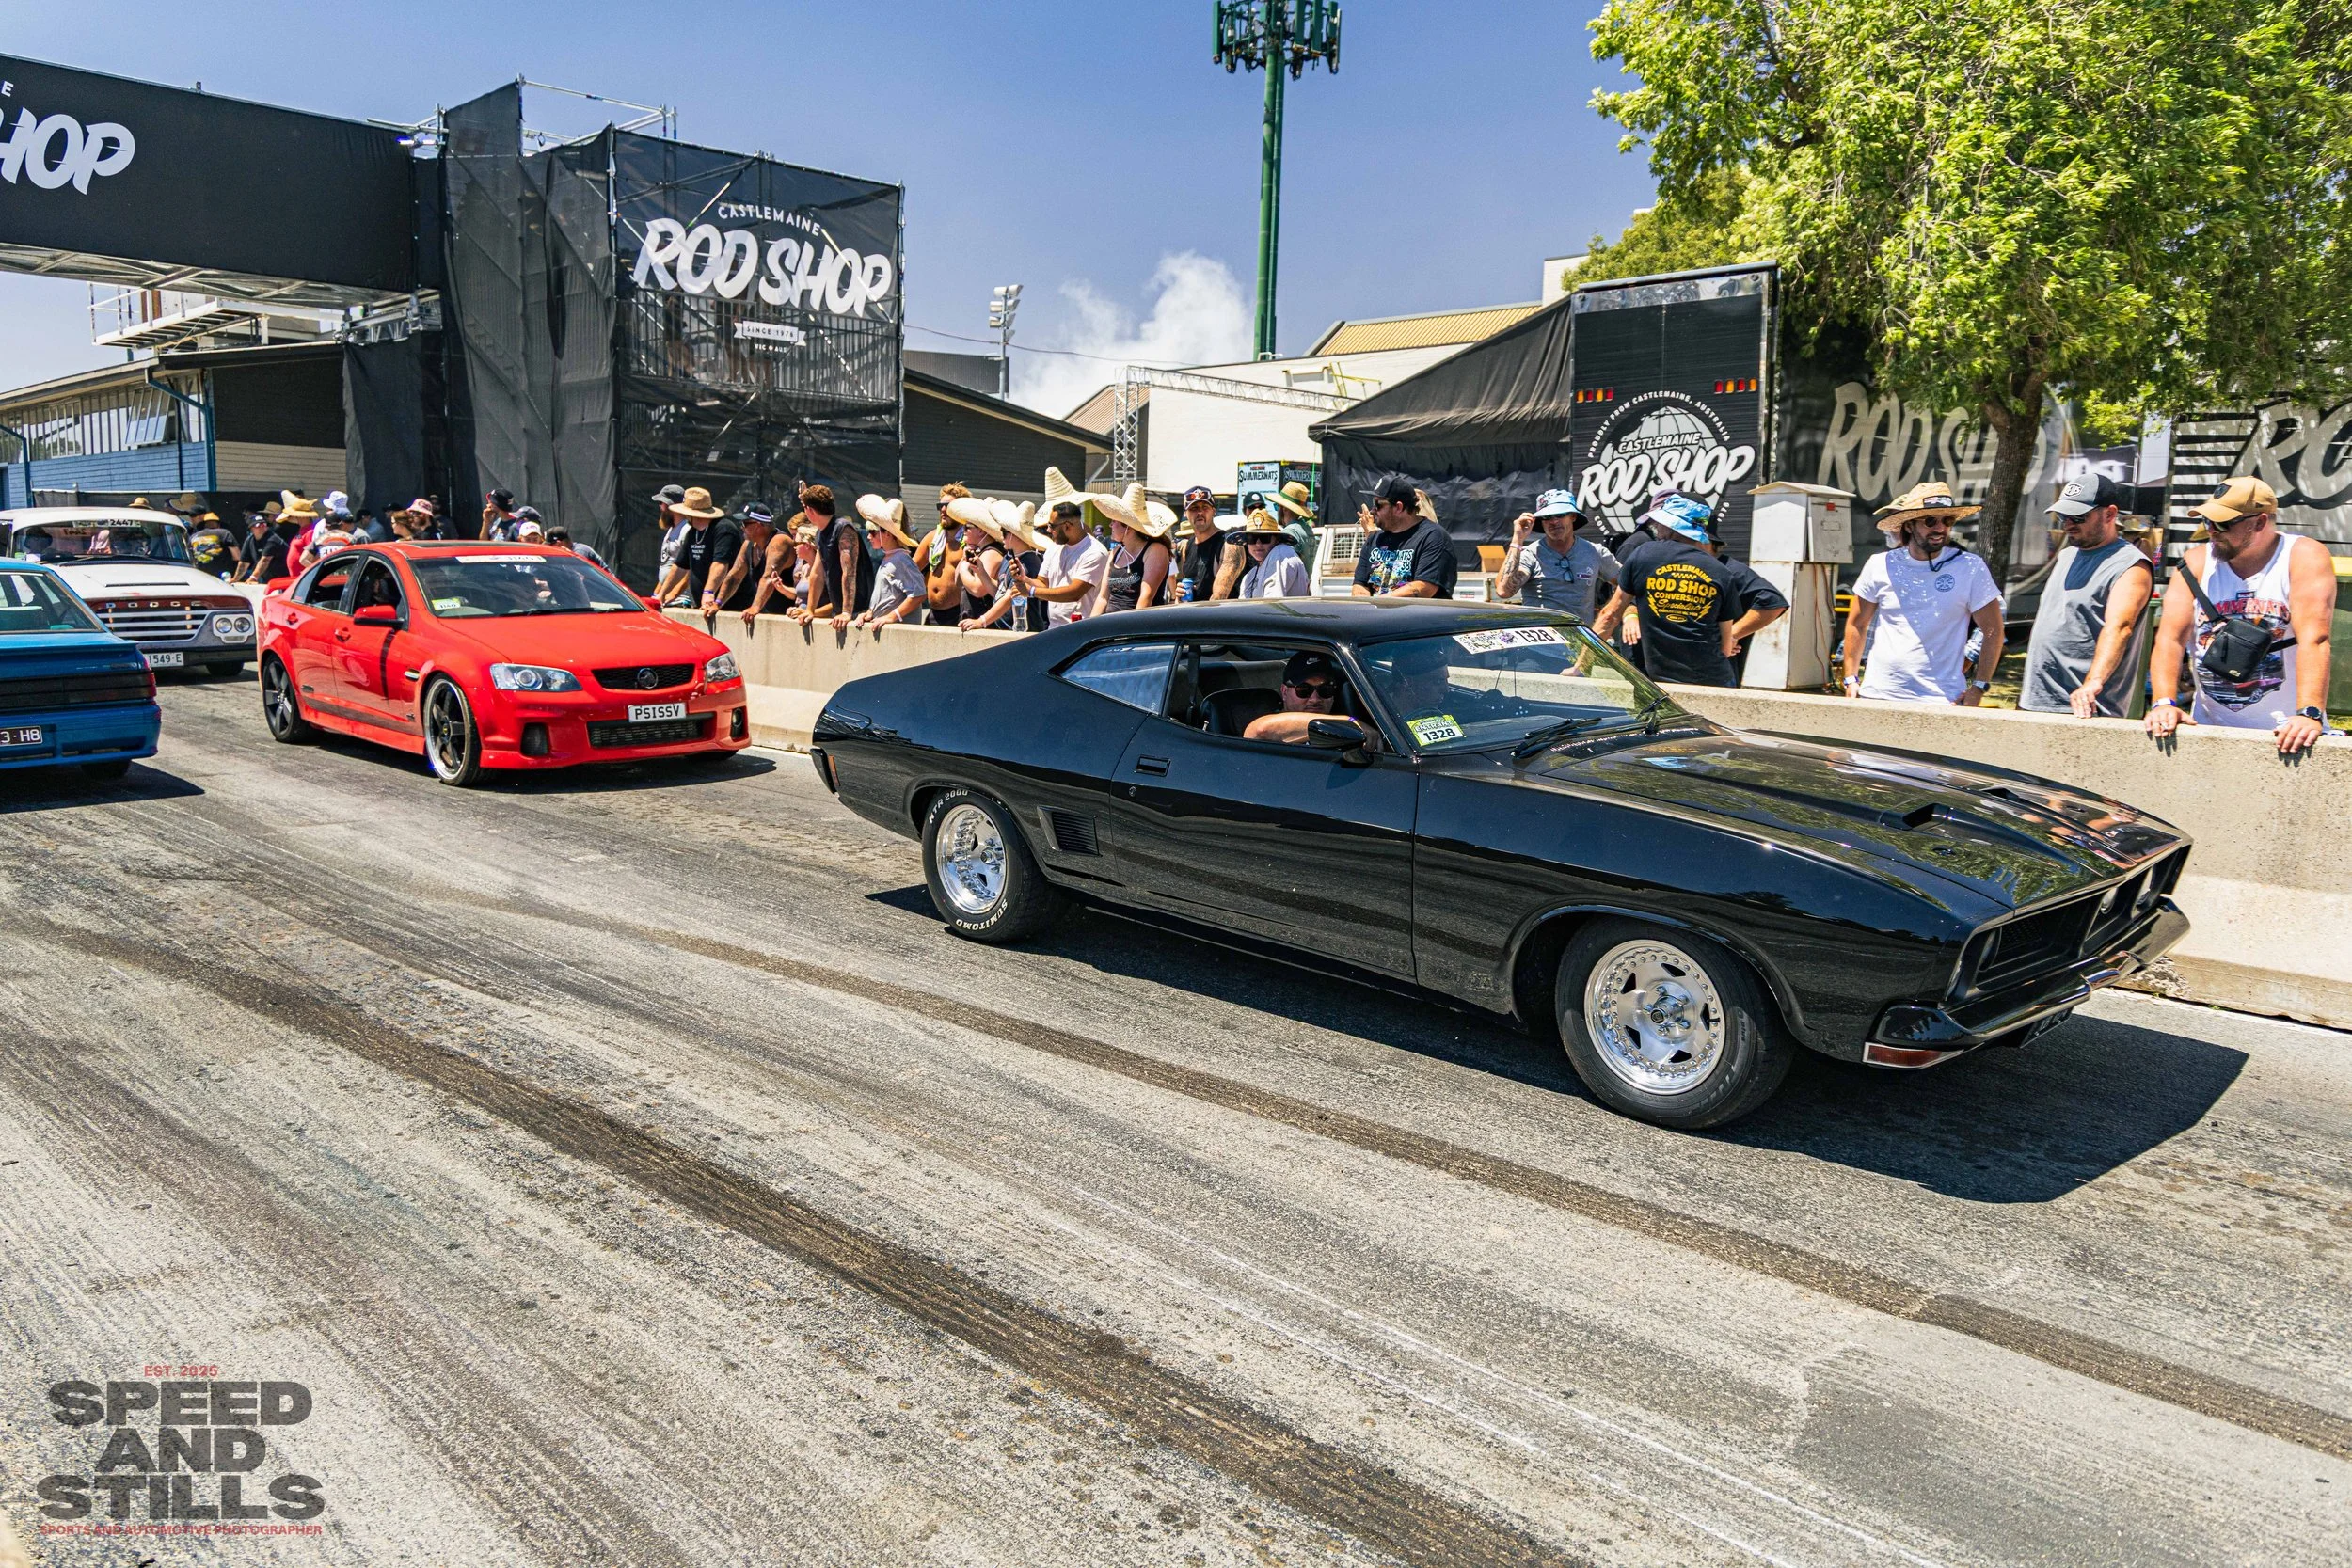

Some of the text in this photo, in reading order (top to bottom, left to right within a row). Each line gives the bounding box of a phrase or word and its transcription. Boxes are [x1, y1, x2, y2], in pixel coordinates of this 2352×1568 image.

[718, 204, 821, 236] CASTLEMAINE
[633, 218, 892, 318] ROD SHOP
[746, 325, 794, 338] SINCE 1976
[1587, 420, 1611, 458] PROUDLY
[1609, 402, 1631, 420] FROM
[1694, 401, 1731, 442] AUSTRALIA
[1618, 431, 1702, 454] CASTLEMAINE
[1818, 381, 1932, 501] ROD
[1238, 470, 1279, 483] SUMMERNATS
[1575, 445, 1756, 511] ROD SHOP
[1401, 561, 1411, 571] 38
[1656, 563, 1713, 583] CASTLEMAINE
[1647, 577, 1718, 598] ROD SHOP
[105, 600, 203, 609] DODGE
[1654, 592, 1707, 605] CONVERSION
[1515, 629, 1556, 643] 1328
[634, 704, 680, 720] PSISSV
[1414, 720, 1454, 733] ENTRANT
[1422, 728, 1456, 741] 1328
[956, 898, 1008, 931] SUMITOMO
